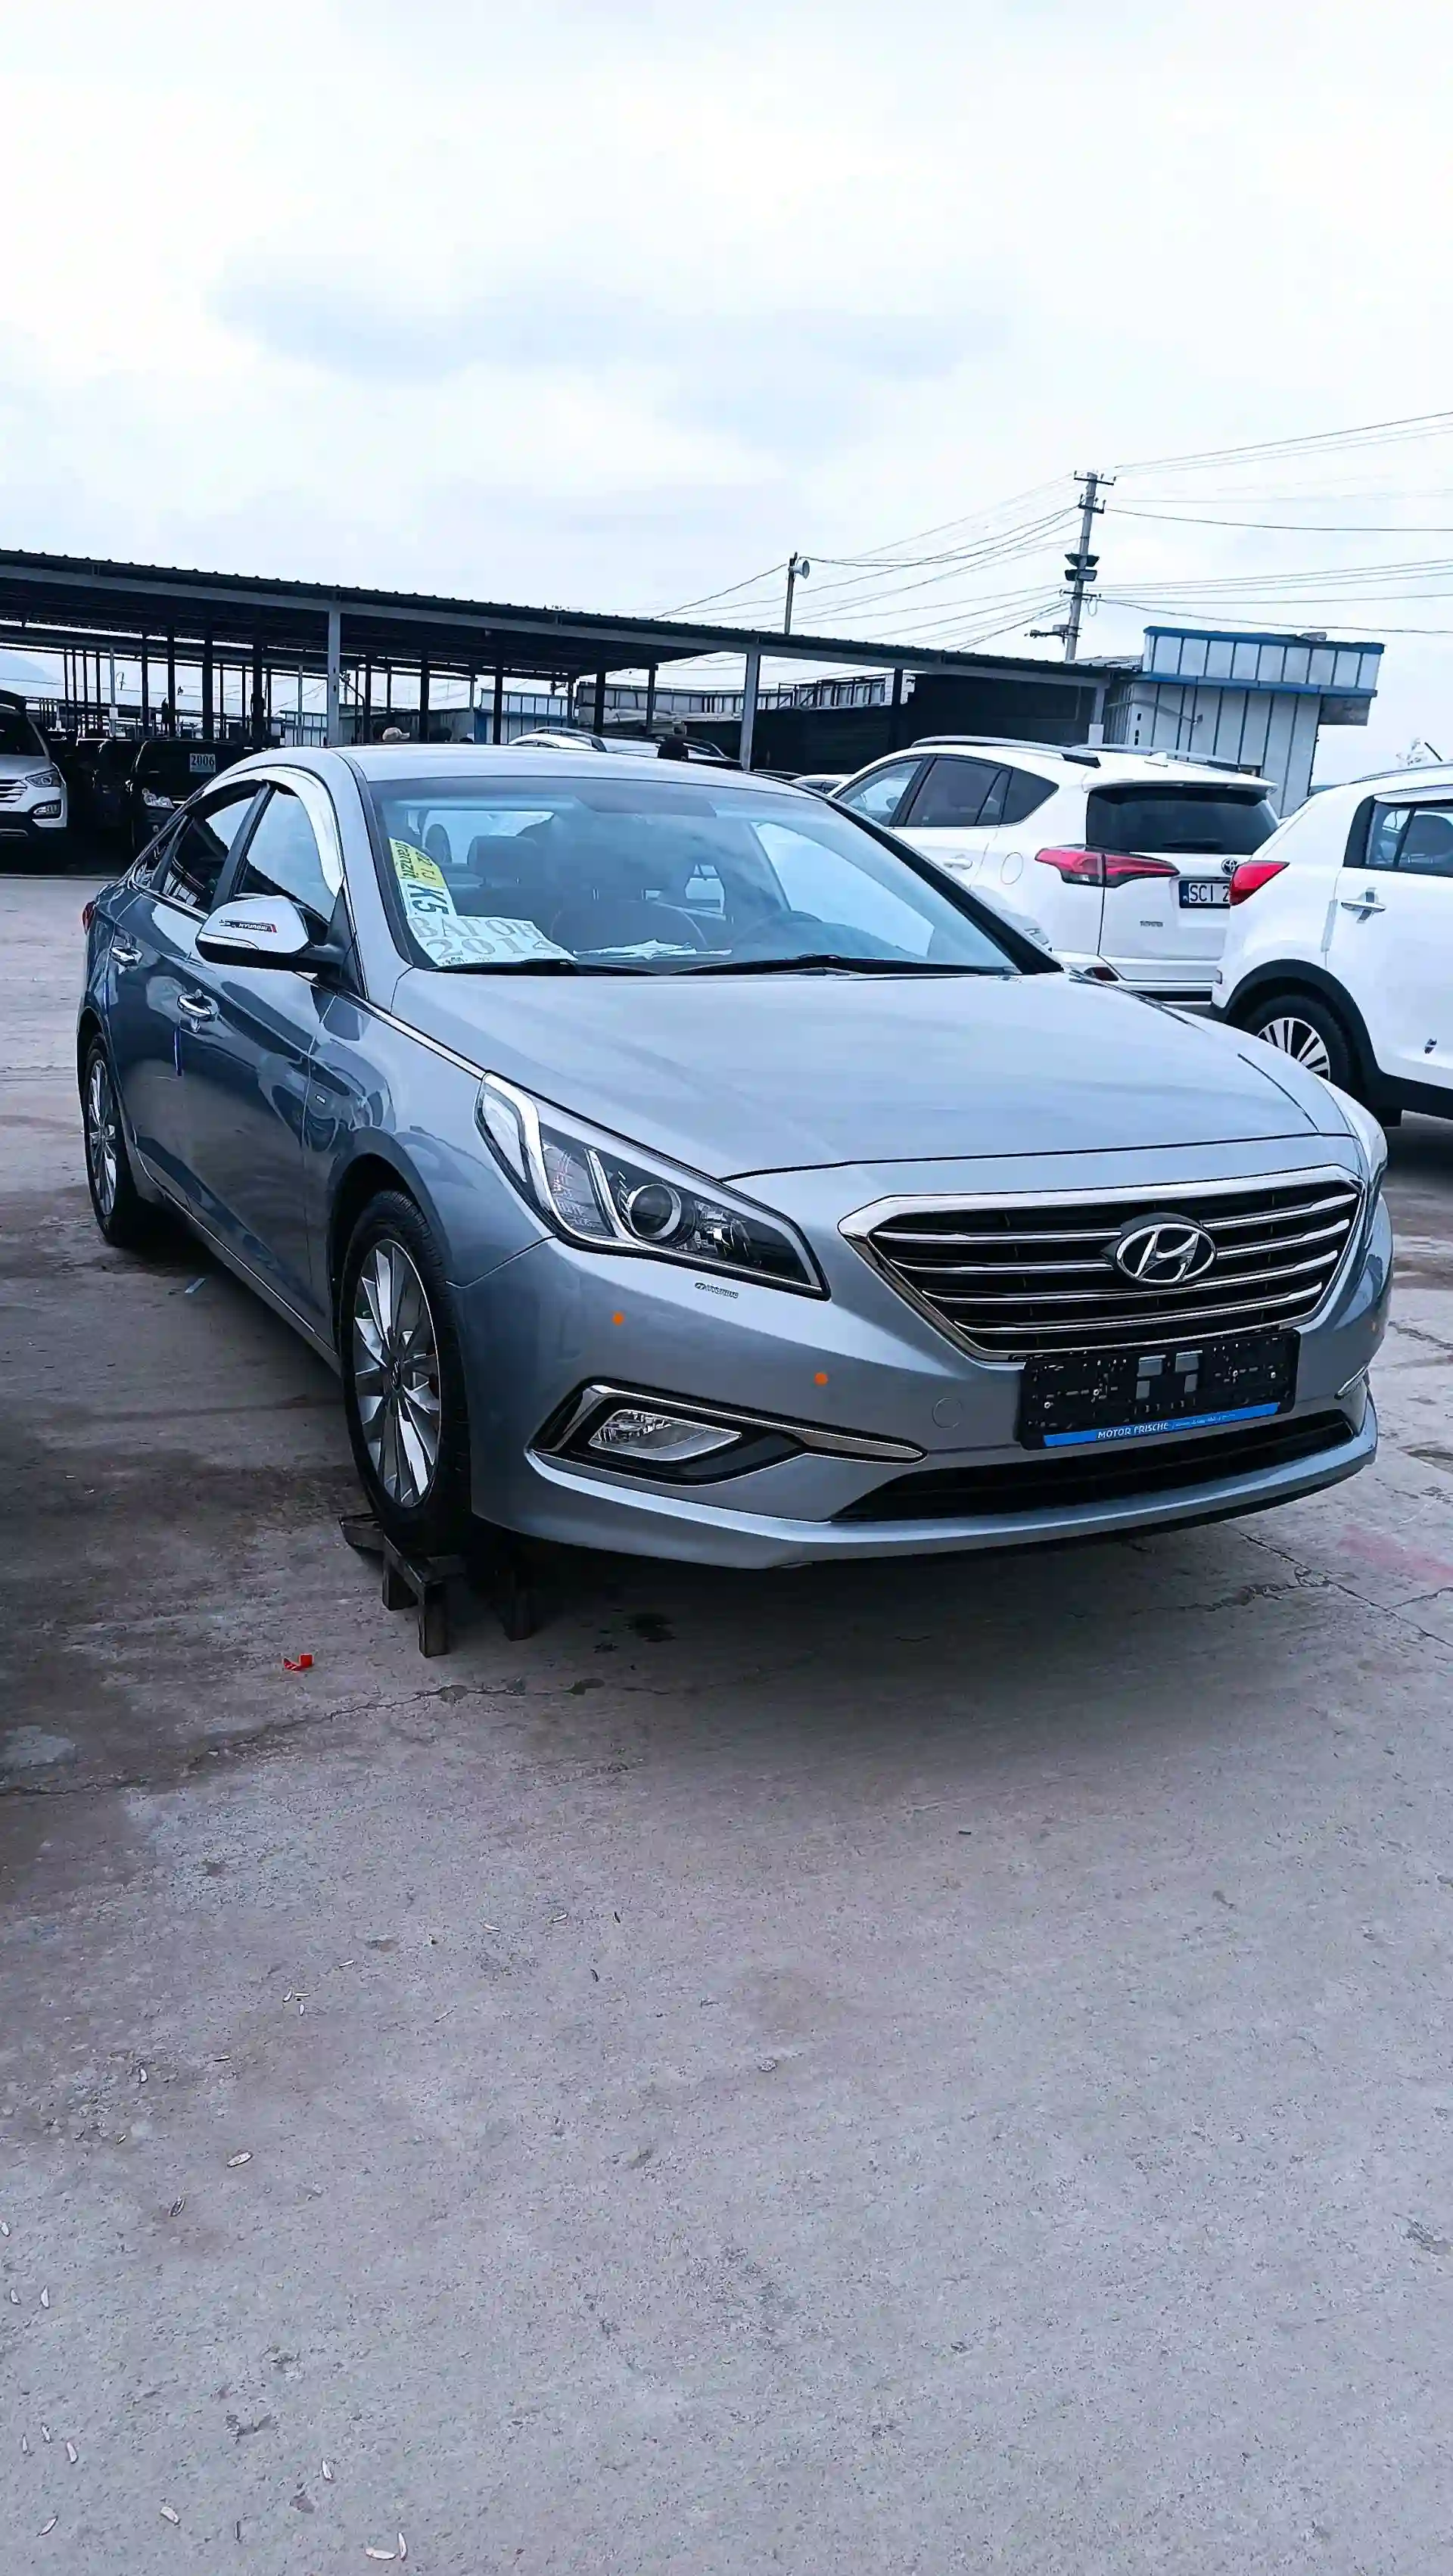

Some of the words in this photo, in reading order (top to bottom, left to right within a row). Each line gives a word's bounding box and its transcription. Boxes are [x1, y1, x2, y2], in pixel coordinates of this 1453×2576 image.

[191, 755, 215, 766] 2006
[1190, 884, 1214, 902] SCI
[238, 922, 268, 931] HYUNDAI
[412, 917, 544, 940] ВАГОН
[1097, 1426, 1131, 1439] MOTOR
[1134, 1422, 1169, 1434] FRISCHE
